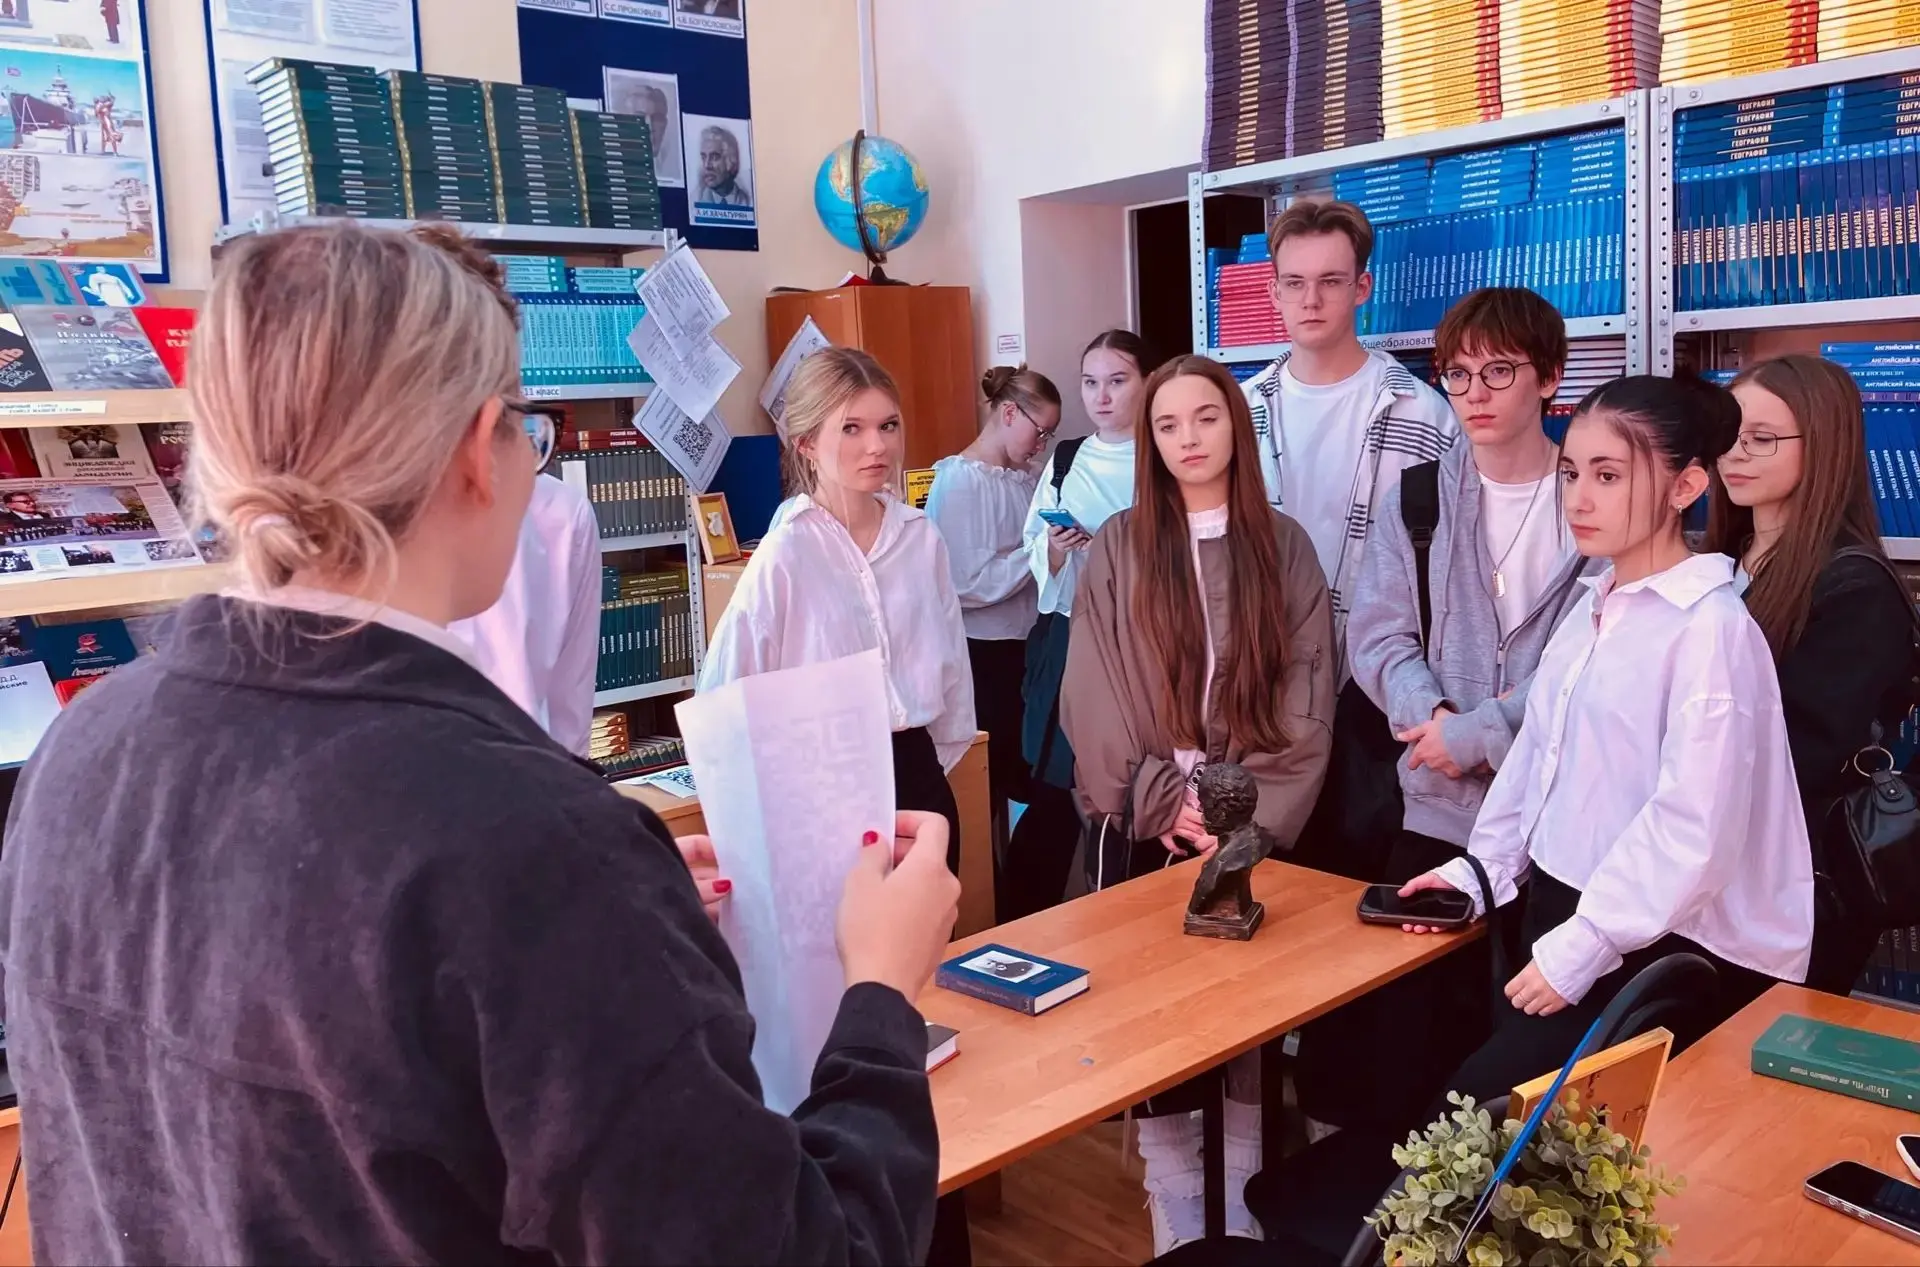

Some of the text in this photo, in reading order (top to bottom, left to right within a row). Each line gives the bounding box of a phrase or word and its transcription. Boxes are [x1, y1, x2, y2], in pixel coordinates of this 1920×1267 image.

[1736, 111, 1775, 124] ГЕОГРАФИЯ
[1737, 98, 1775, 111] ГЕОГРАФИЯ
[1731, 136, 1769, 148] ГЕОГРАФИЯ
[1734, 124, 1772, 137] ГЕОГРАФИЯ
[1730, 148, 1768, 160] ГЕОГРАФИЯ
[1739, 224, 1747, 260] ГЕОГРАФИЯ
[1750, 222, 1759, 258] ГЕОГРАФИЯ
[1763, 221, 1771, 257] ГЕОГРАФИЯ
[1775, 220, 1784, 257] ГЕОГРАФИЯ
[1788, 218, 1796, 255] ГЕОГРАФИЯ
[1802, 217, 1811, 254] ГЕОГРАФИЯ
[1814, 216, 1823, 252] ГЕОГРАФИЯ
[1827, 214, 1836, 251] ГЕОГРАФИЯ
[1840, 212, 1850, 250] ГЕОГРАФИЯ
[1853, 211, 1862, 248] ГЕОГРАФИЯ
[1866, 209, 1876, 248] ГЕОГРАФИЯ
[1880, 208, 1890, 246] ГЕОГРАФИЯ
[1894, 207, 1904, 245] ГЕОГРАФИЯ
[1908, 205, 1917, 243] ГЕОГРАФИЯ
[1693, 229, 1701, 264] ГЕОГРАФИЯ
[1705, 228, 1713, 263] ГЕОГРАФИЯ
[1717, 227, 1725, 262] ГЕОГРАФИЯ
[1728, 225, 1736, 261] ГЕОГРАФИЯ
[1358, 337, 1436, 349] бщеобразовате
[525, 388, 534, 396] 11
